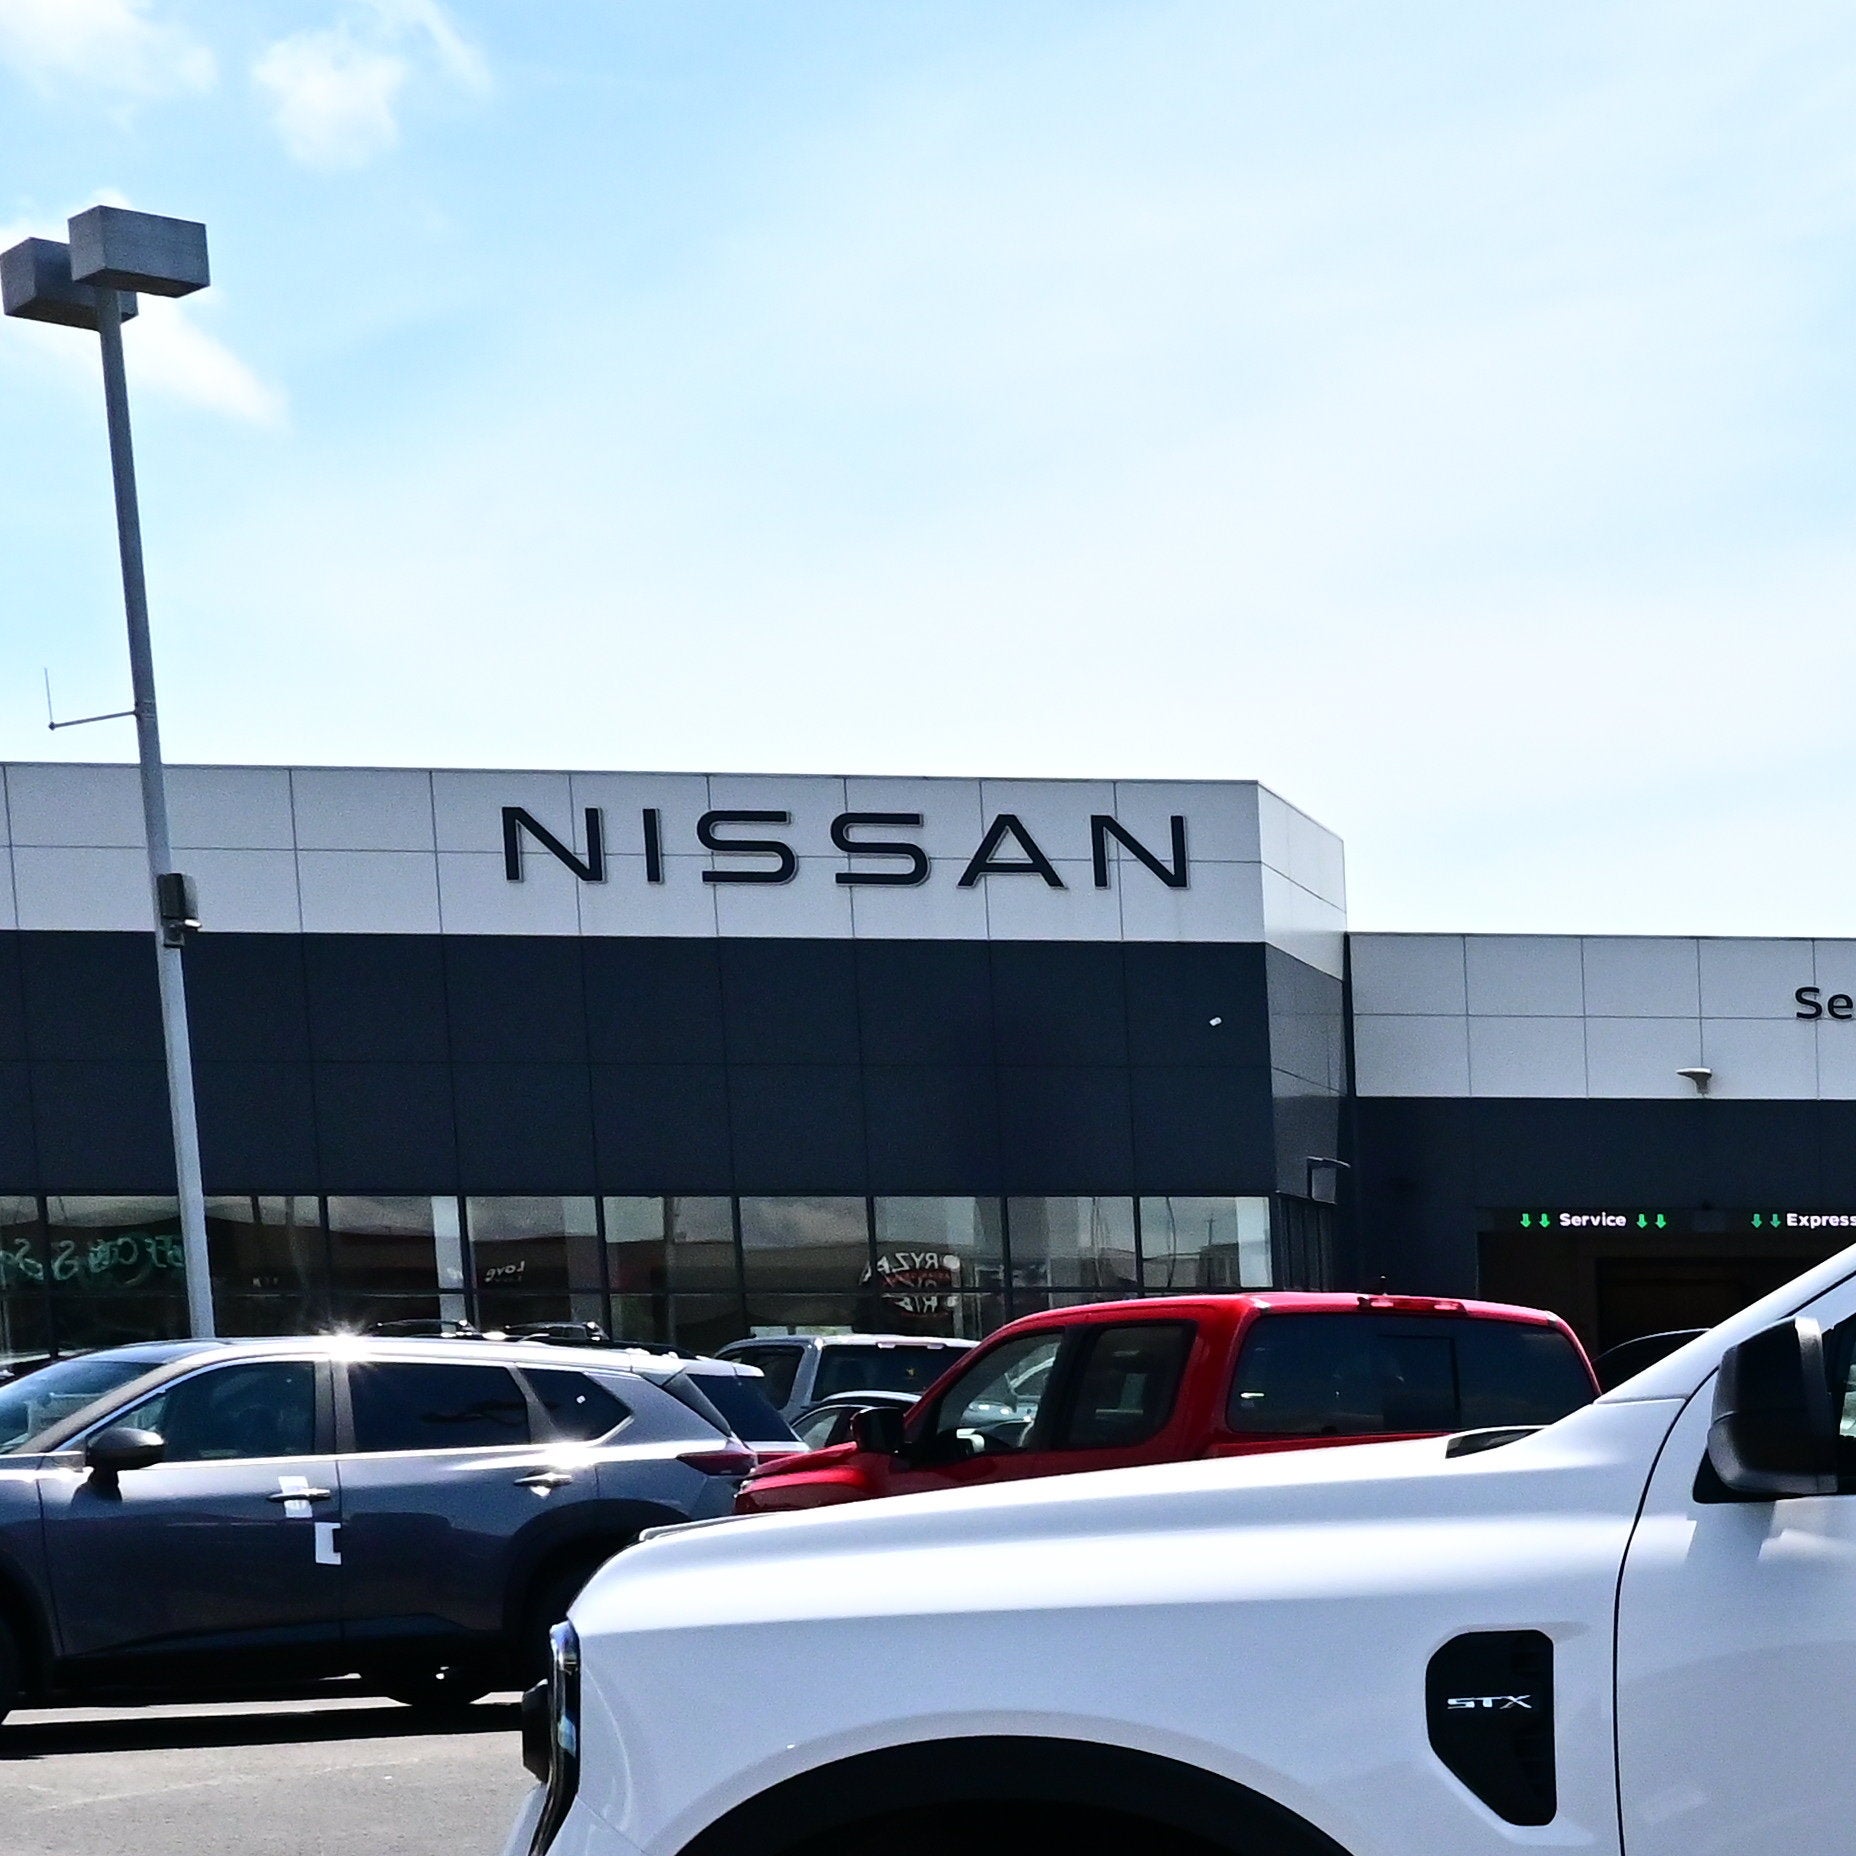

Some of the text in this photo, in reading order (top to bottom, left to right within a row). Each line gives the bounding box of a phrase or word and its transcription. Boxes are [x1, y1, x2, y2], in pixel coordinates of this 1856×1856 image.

[501, 806, 1190, 890] NISSAN
[1559, 1212, 1627, 1227] Service
[1447, 1694, 1532, 1709] STX
